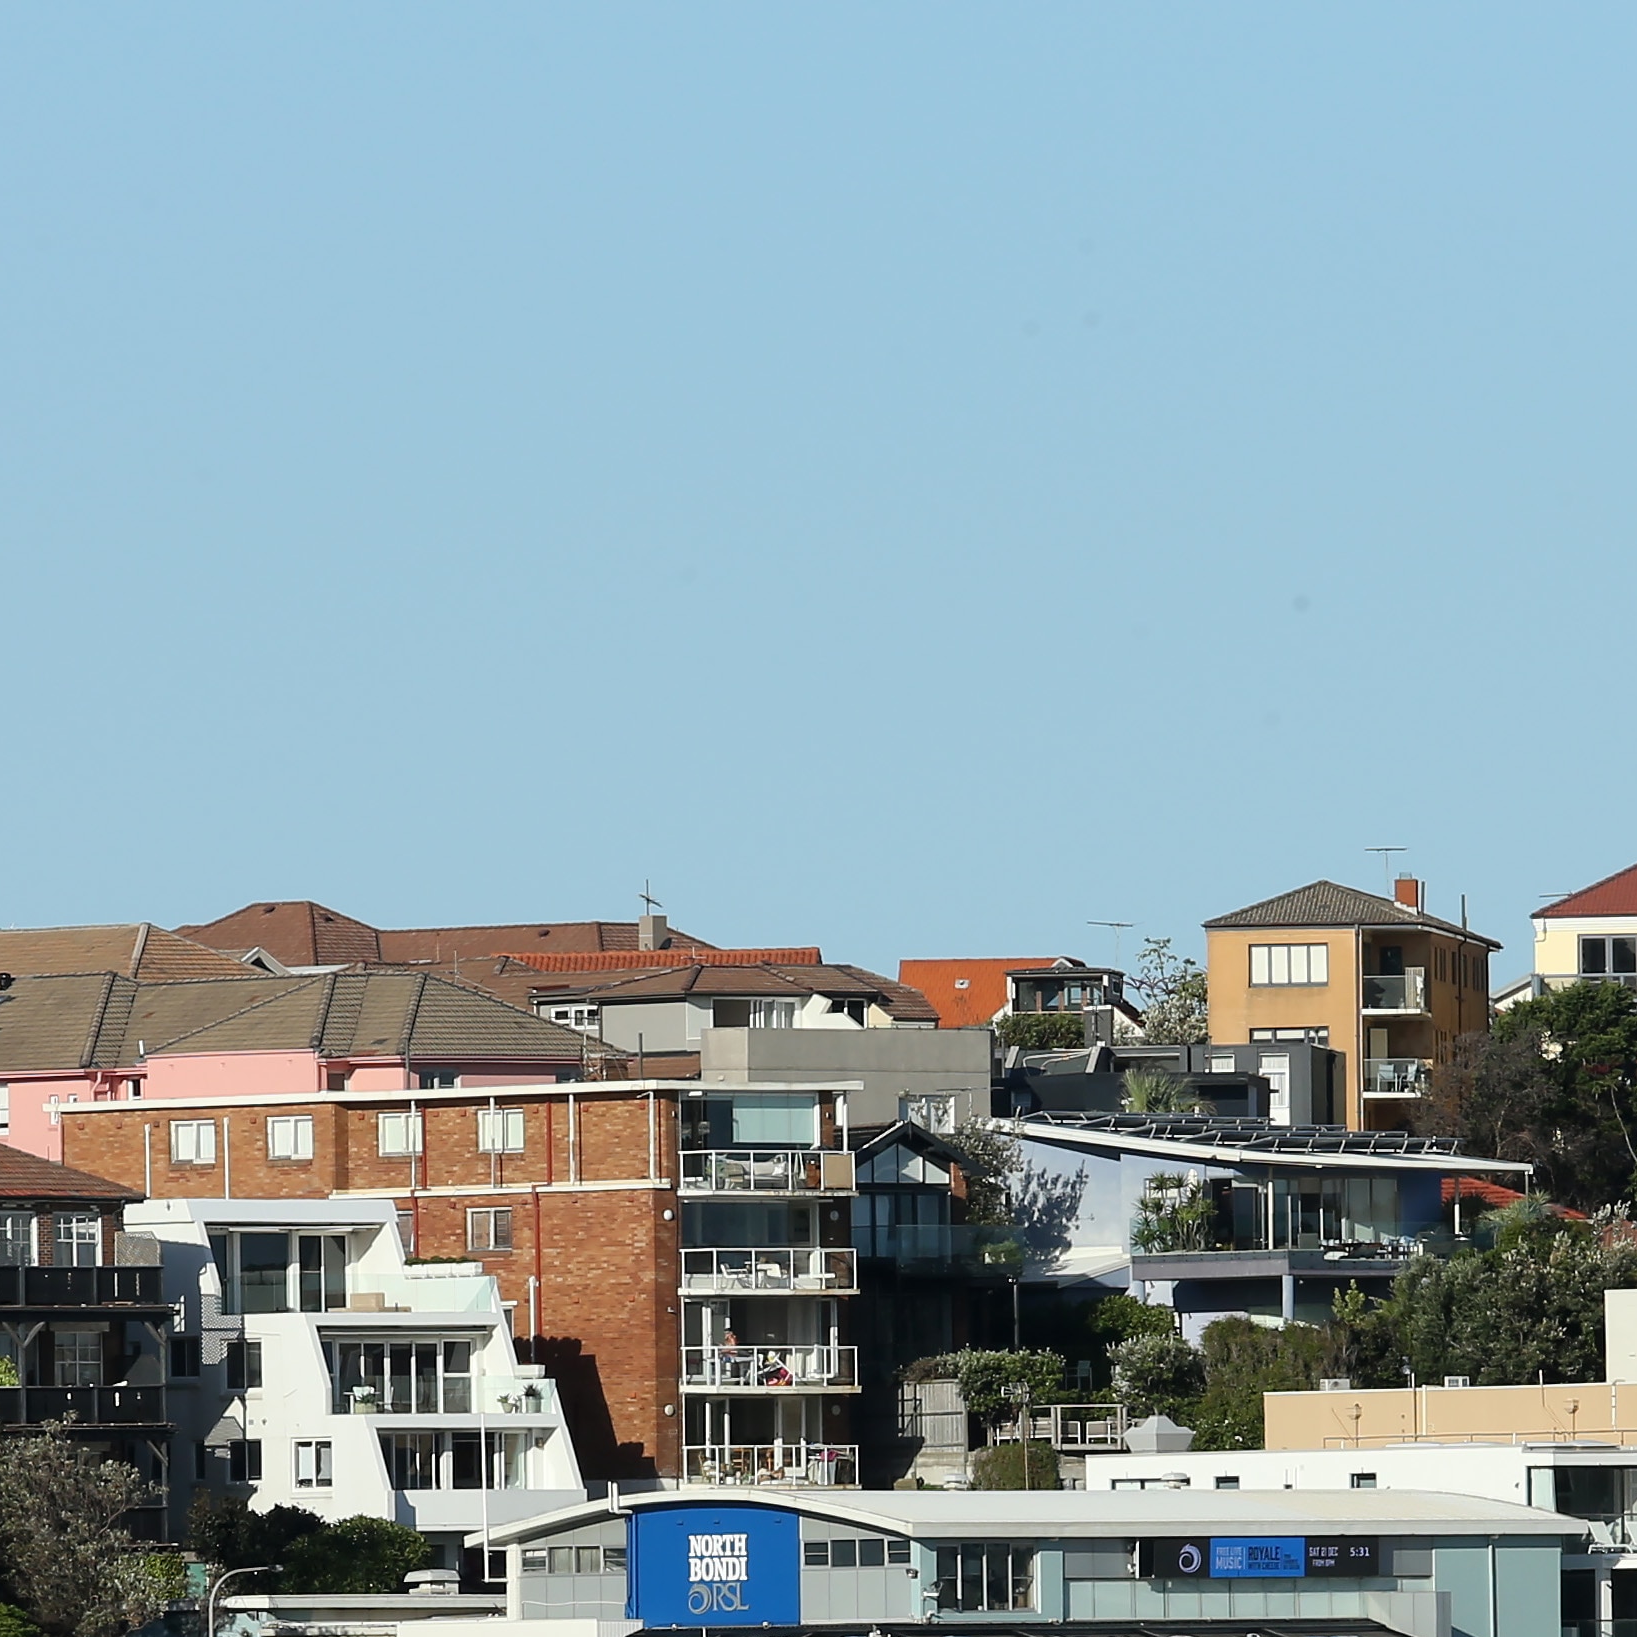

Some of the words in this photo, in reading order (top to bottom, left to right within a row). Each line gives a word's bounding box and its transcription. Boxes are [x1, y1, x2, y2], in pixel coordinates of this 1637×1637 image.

[688, 1534, 748, 1557] NORTH
[1248, 1546, 1280, 1560] ROYALE
[1350, 1546, 1370, 1557] 5:31
[689, 1557, 748, 1582] BONDI
[1216, 1556, 1242, 1569] MUSIC
[713, 1583, 749, 1611] RSL
